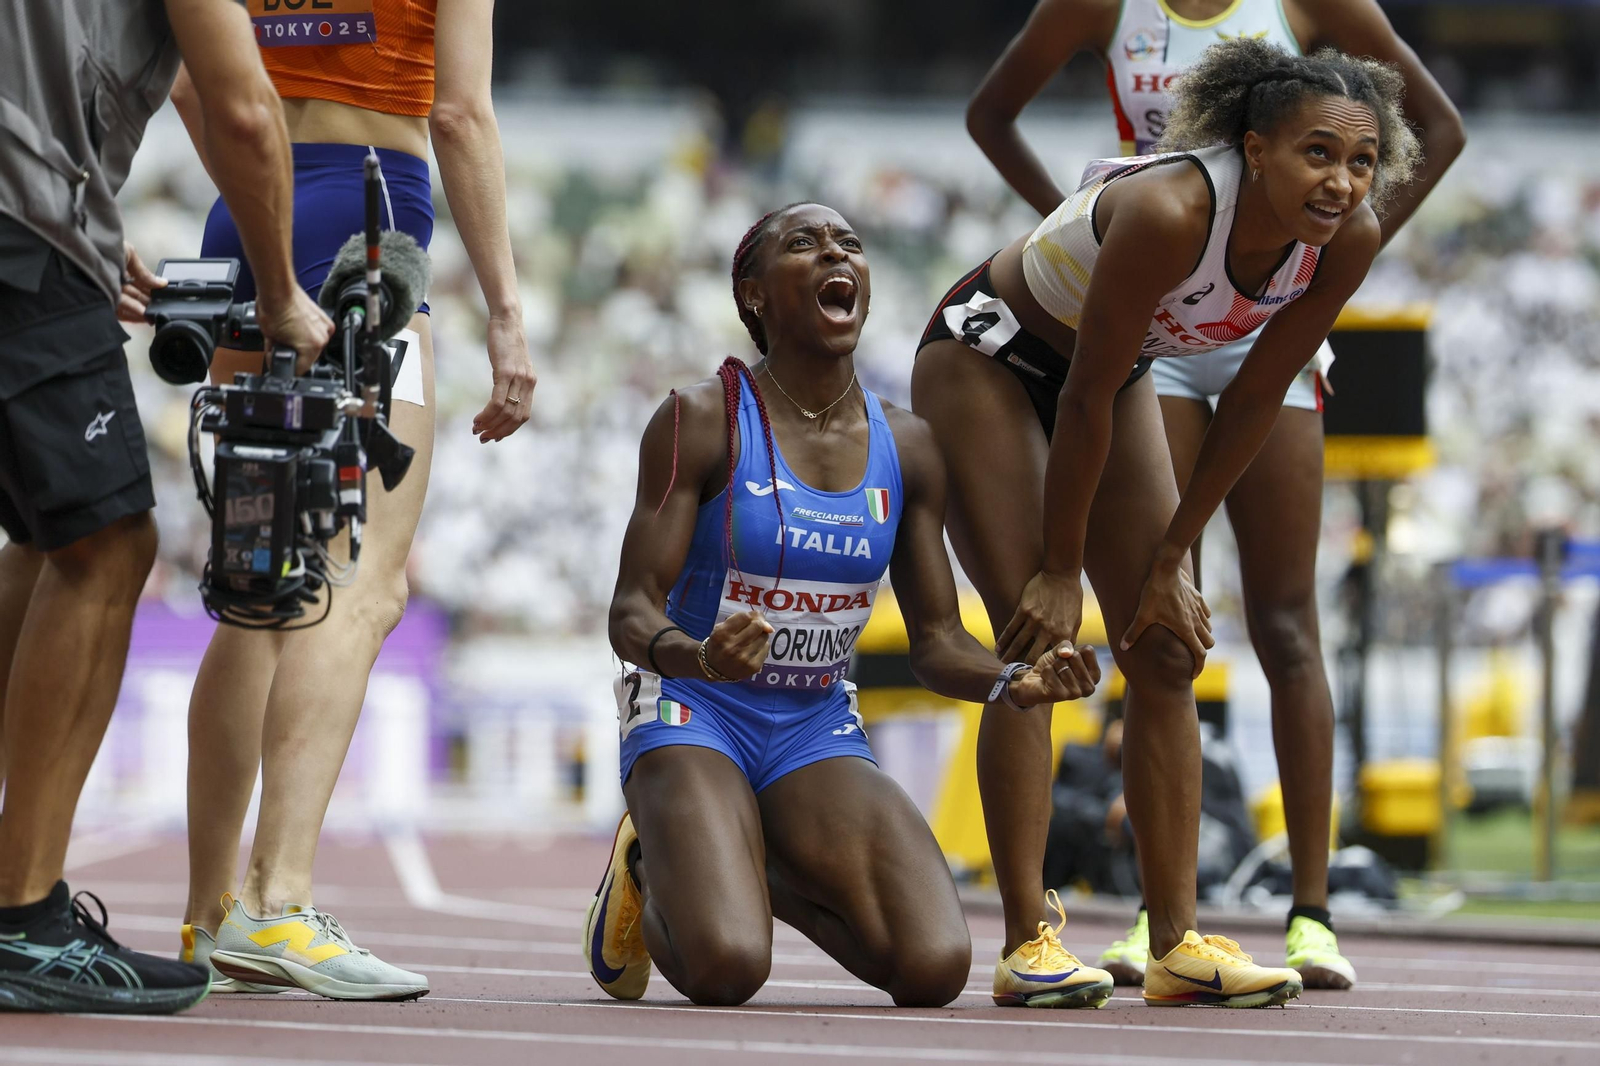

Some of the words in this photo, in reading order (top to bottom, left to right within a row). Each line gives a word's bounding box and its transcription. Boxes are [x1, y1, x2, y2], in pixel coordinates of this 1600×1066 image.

[264, 21, 333, 38] TOKYO
[793, 506, 864, 523] FRECCIAROSSA
[775, 524, 872, 560] ITALIA
[725, 580, 871, 613] HONDA
[769, 625, 860, 663] ORUNSO
[624, 672, 642, 725] 2
